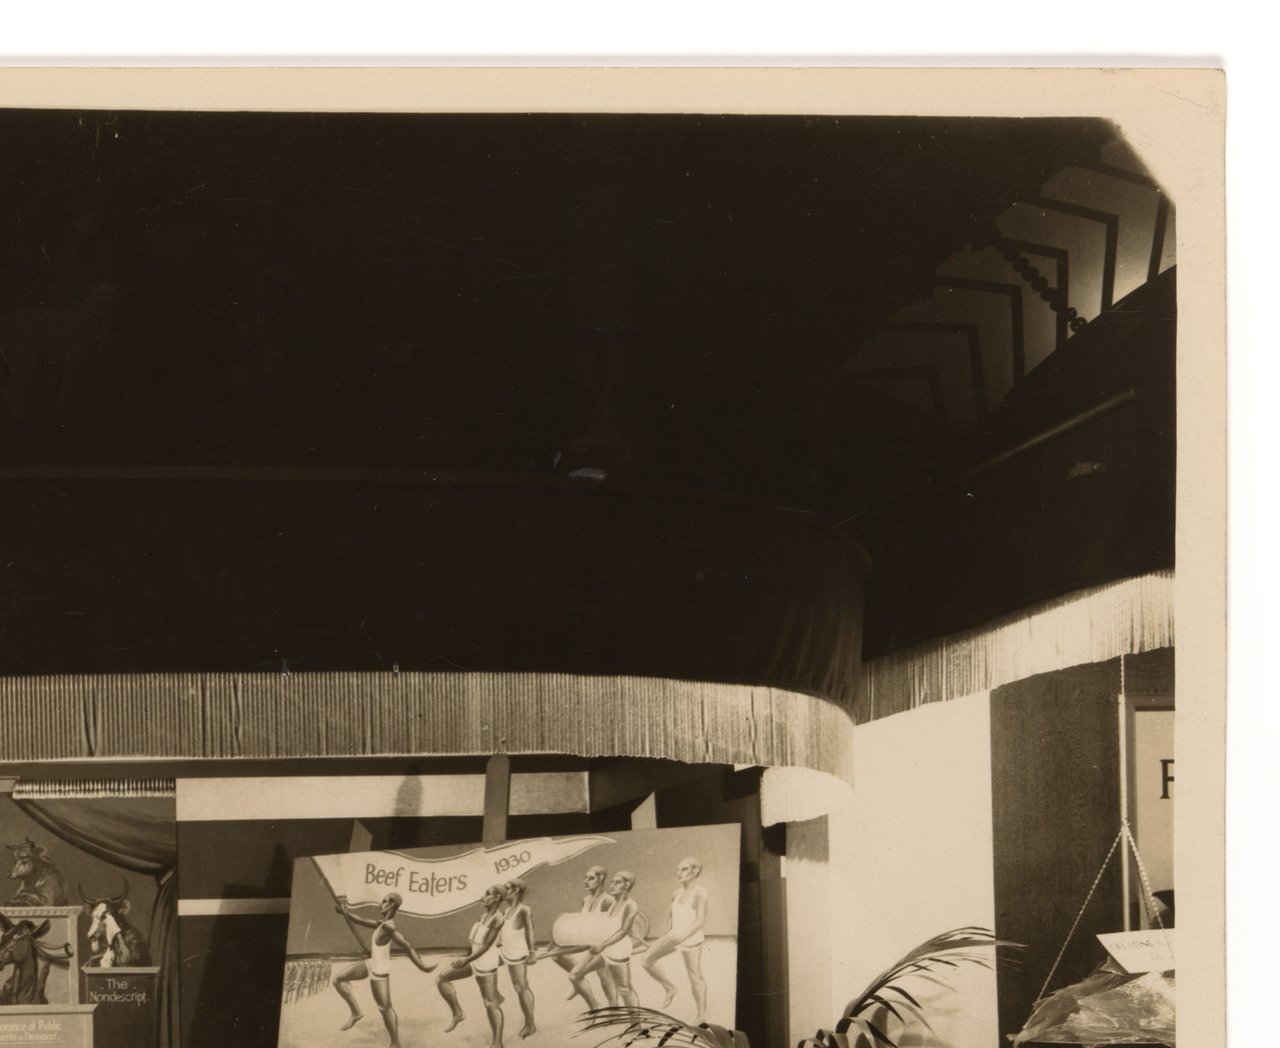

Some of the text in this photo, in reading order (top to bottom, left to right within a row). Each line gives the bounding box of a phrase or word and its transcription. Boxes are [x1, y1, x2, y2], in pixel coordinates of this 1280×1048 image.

[365, 850, 532, 897] Beef Eaters 1930
[107, 978, 128, 990] The
